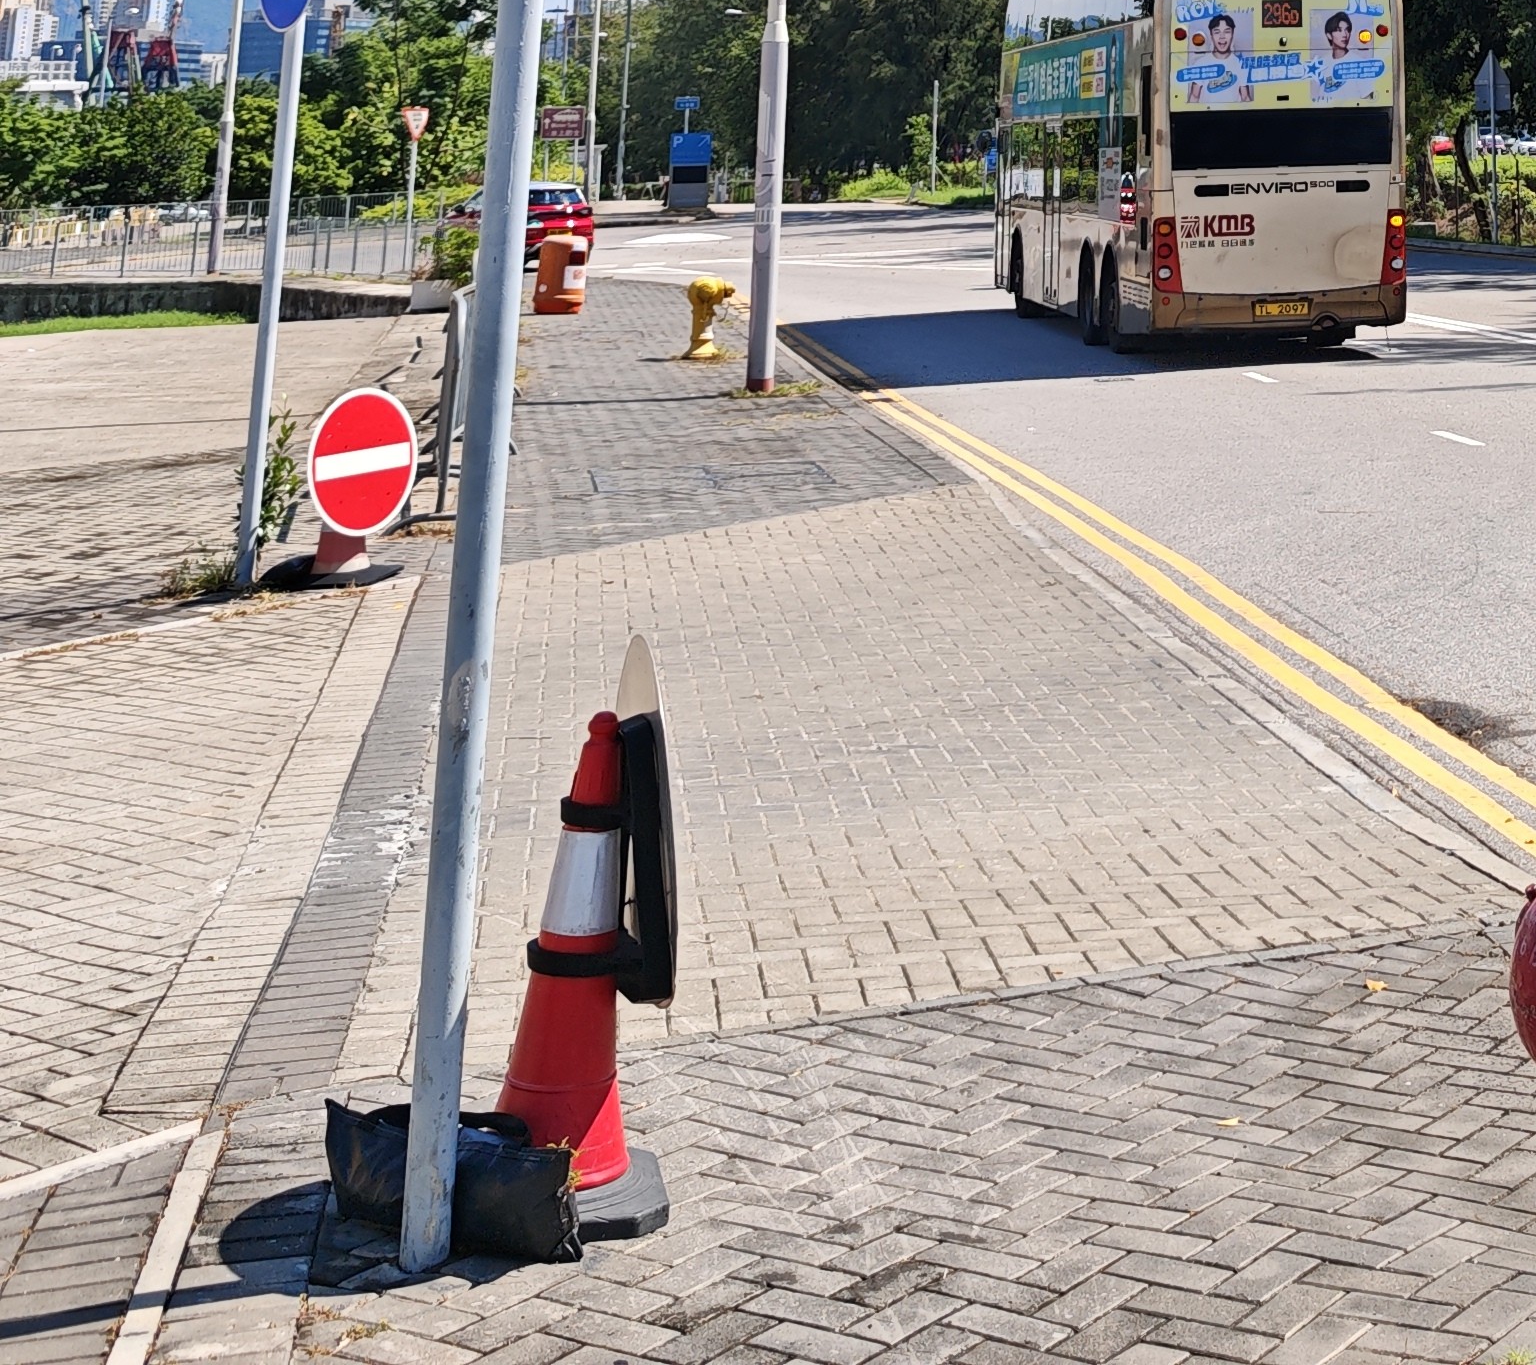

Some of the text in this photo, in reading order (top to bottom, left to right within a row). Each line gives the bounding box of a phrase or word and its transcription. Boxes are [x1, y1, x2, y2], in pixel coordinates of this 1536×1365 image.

[673, 136, 683, 147] P
[1204, 214, 1255, 237] KMB
[1259, 303, 1306, 315] TL 2097
